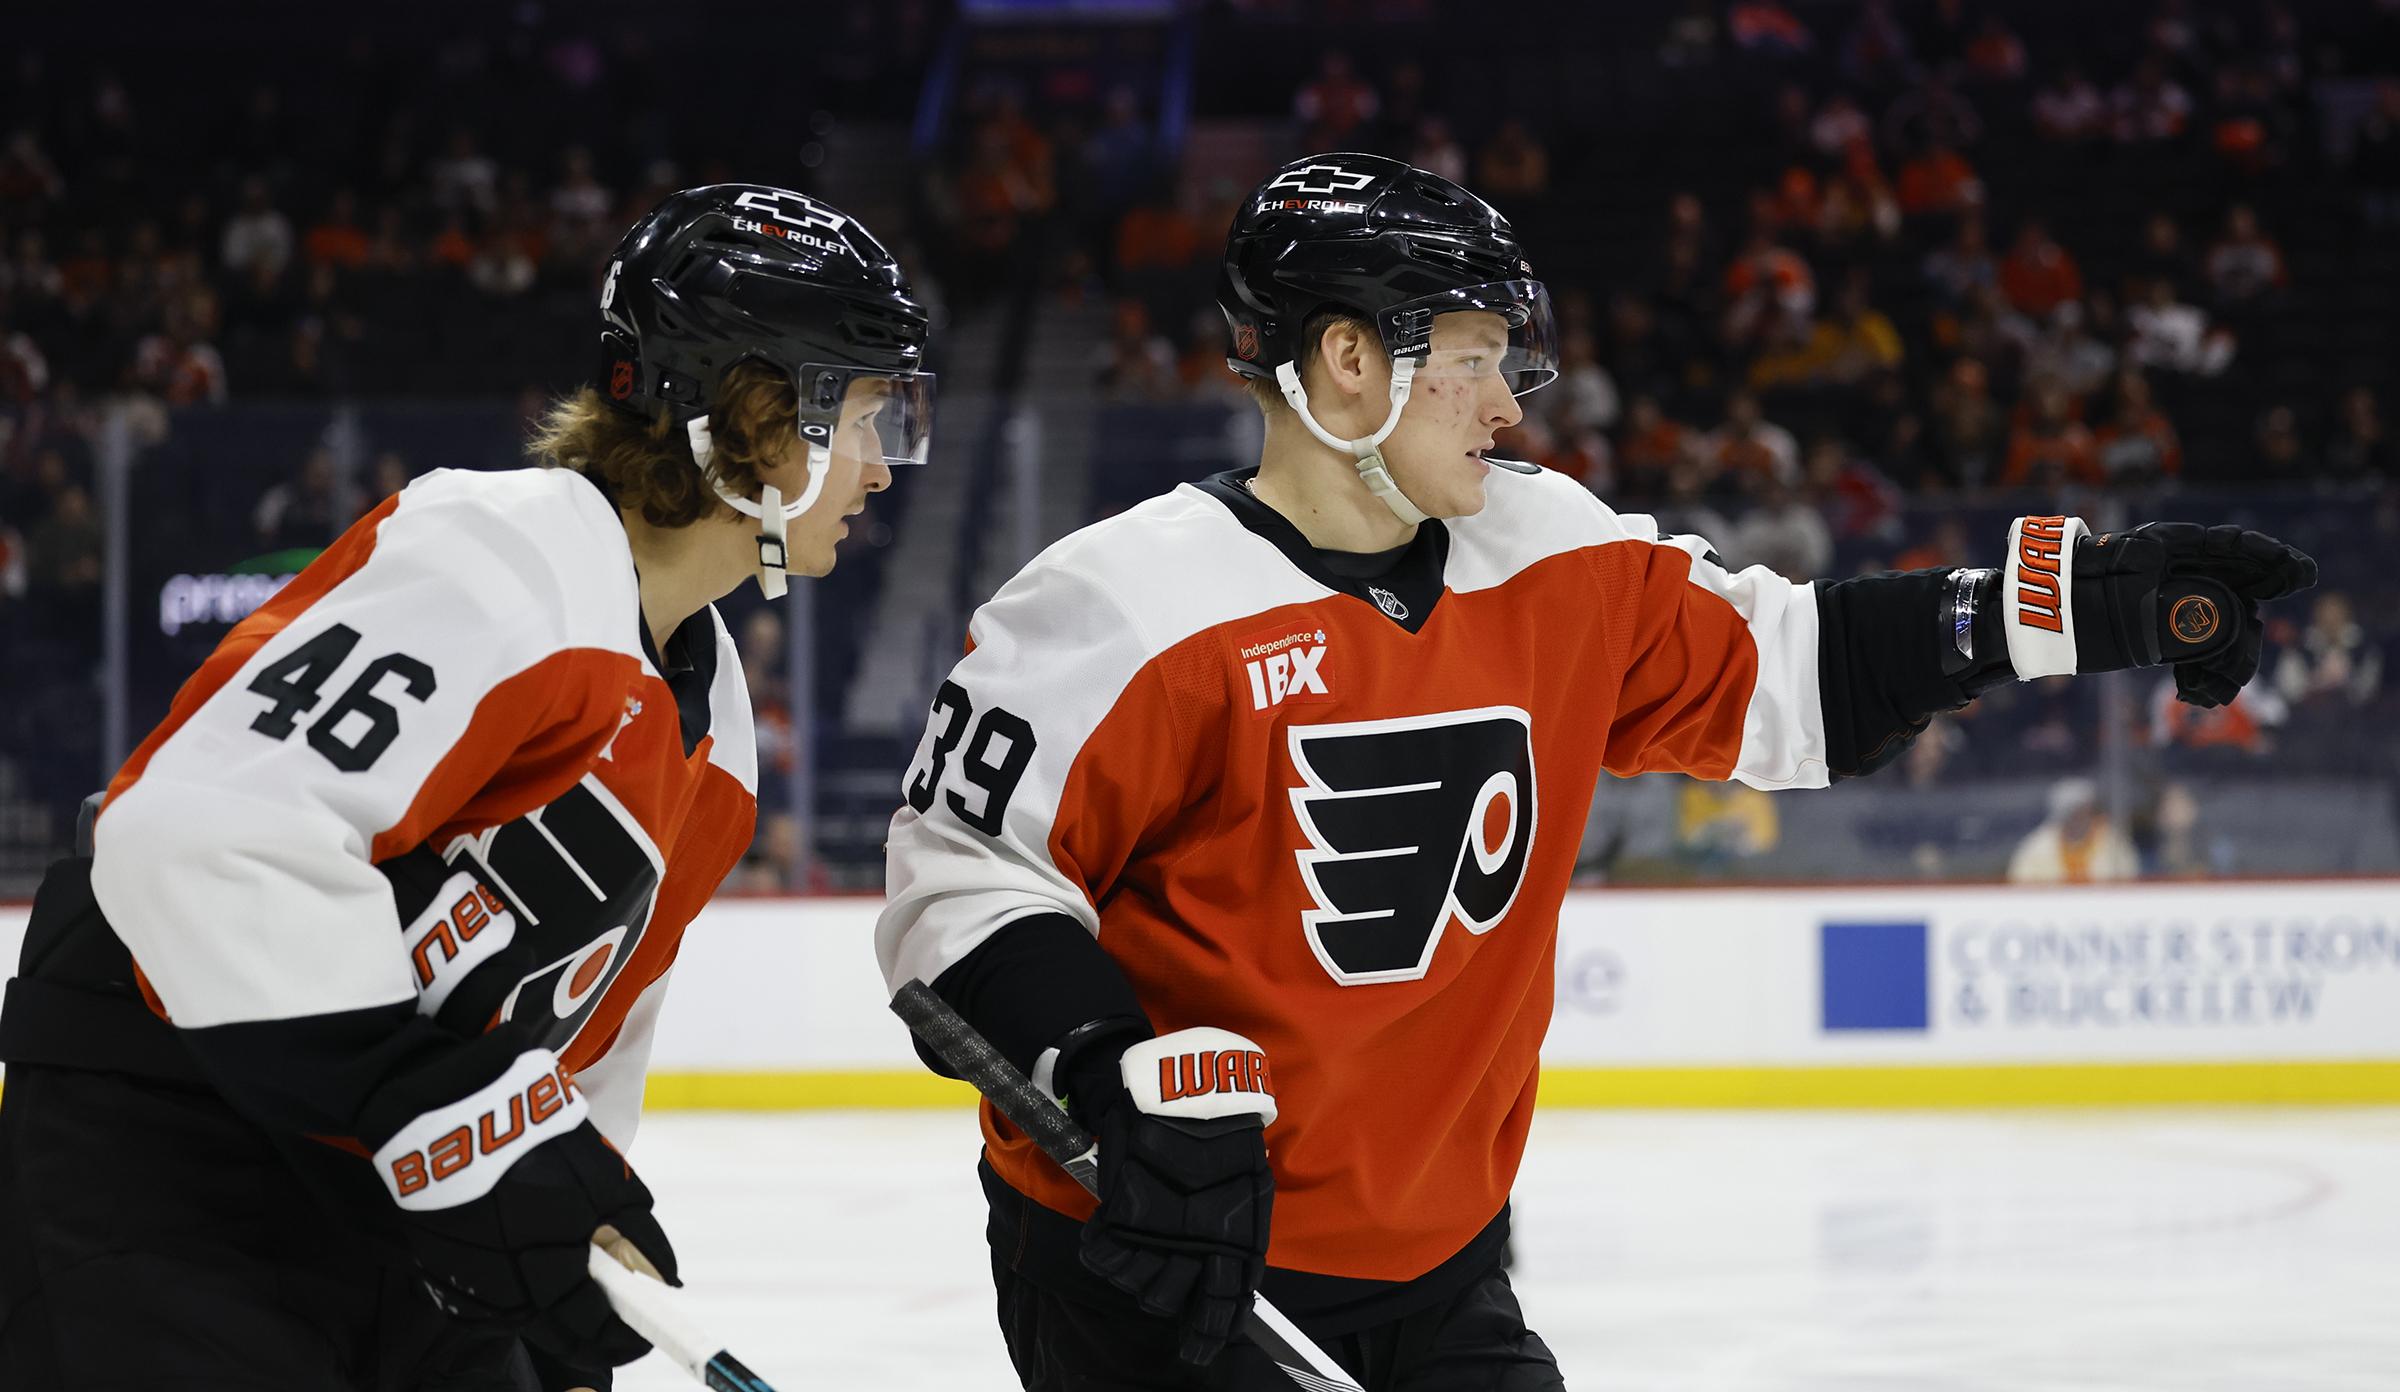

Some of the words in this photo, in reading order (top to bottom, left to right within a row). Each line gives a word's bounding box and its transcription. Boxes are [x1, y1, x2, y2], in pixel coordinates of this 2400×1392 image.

[1260, 199, 1367, 215] CHEVROLET
[732, 218, 848, 256] CHEVROLET
[1393, 342, 1429, 356] BAUER
[1240, 631, 1312, 659] Independence
[246, 622, 437, 773] 46
[1245, 645, 1329, 711] IBX
[909, 679, 1037, 837] 39
[1950, 918, 2197, 972] CONNER
[1950, 980, 1990, 1030] &
[2005, 976, 2325, 1030] BUCKELEW
[391, 1063, 583, 1197] BAUER
